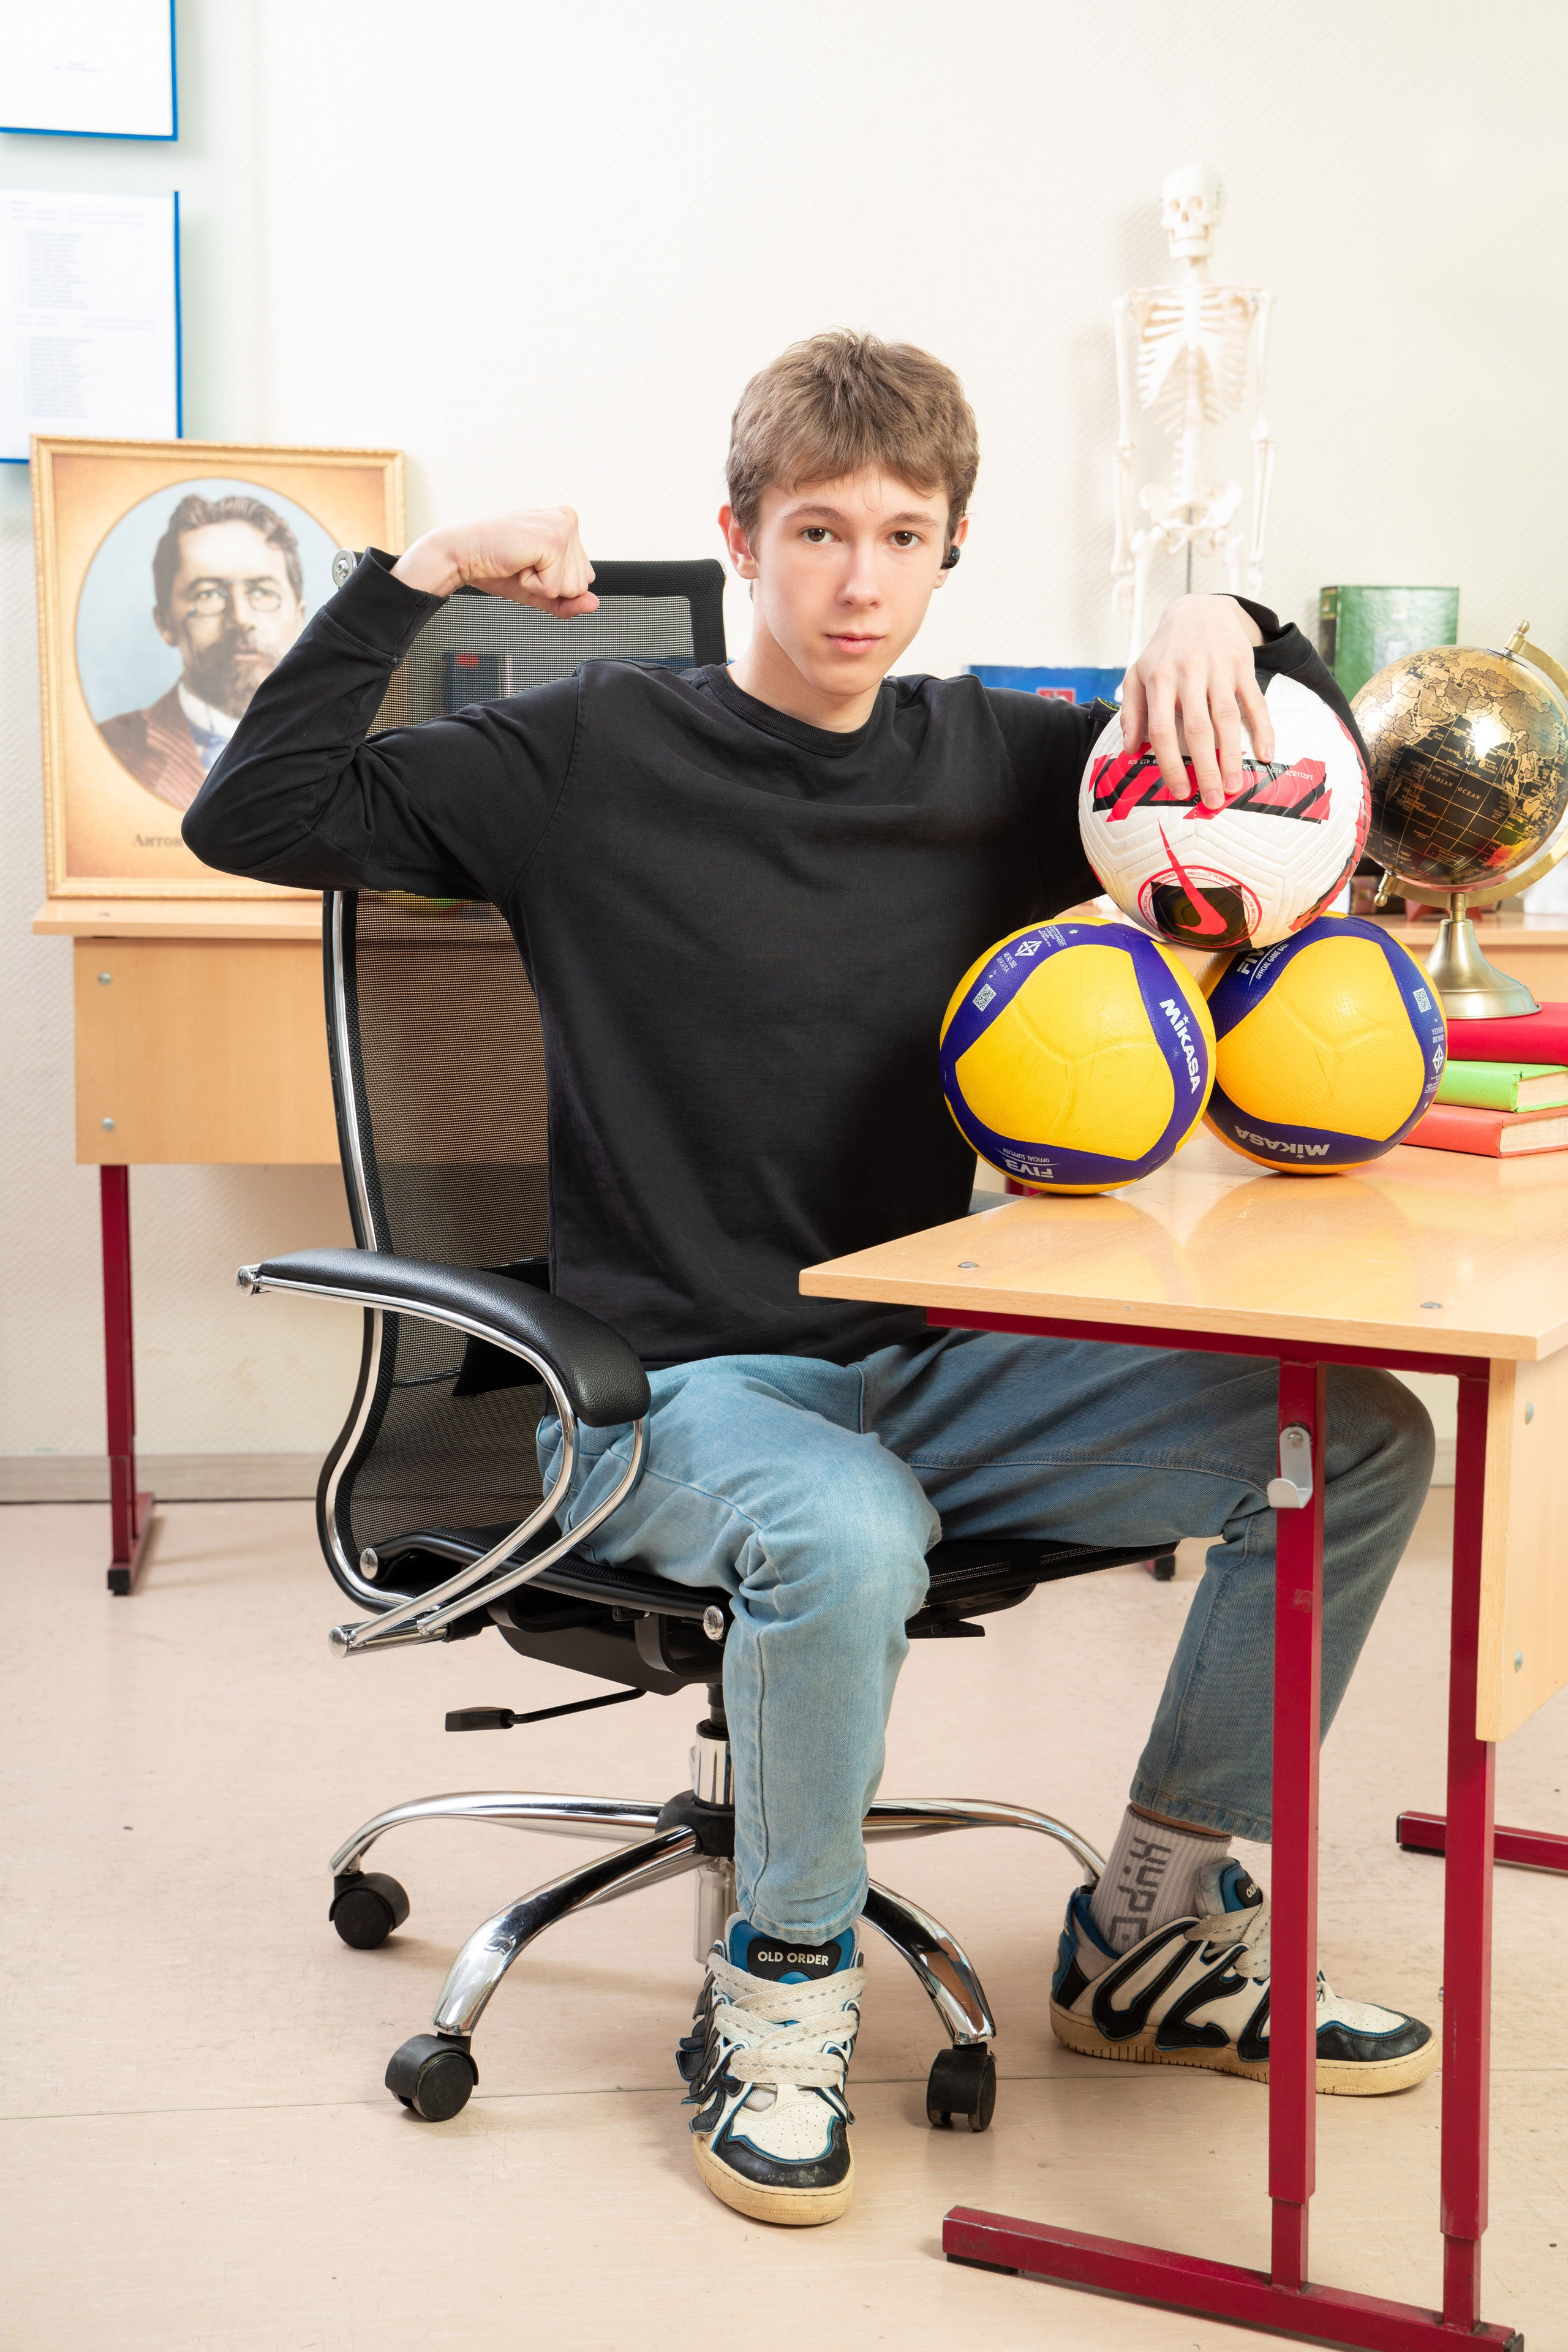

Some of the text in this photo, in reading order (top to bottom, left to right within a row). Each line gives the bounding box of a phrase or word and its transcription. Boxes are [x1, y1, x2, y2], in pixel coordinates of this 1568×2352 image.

[1452, 726, 1468, 735] ARABIAN
[1428, 774, 1481, 800] INDIAN OCEAN
[1439, 849, 1456, 858] LEGEND
[997, 956, 1010, 973] MIKASA
[1256, 943, 1289, 979] OFFICIAL GAME BALL
[1002, 1147, 1026, 1160] SUPPLIER
[1246, 1883, 1256, 1898] OLD
[757, 1951, 829, 1966] OLD ORDER
